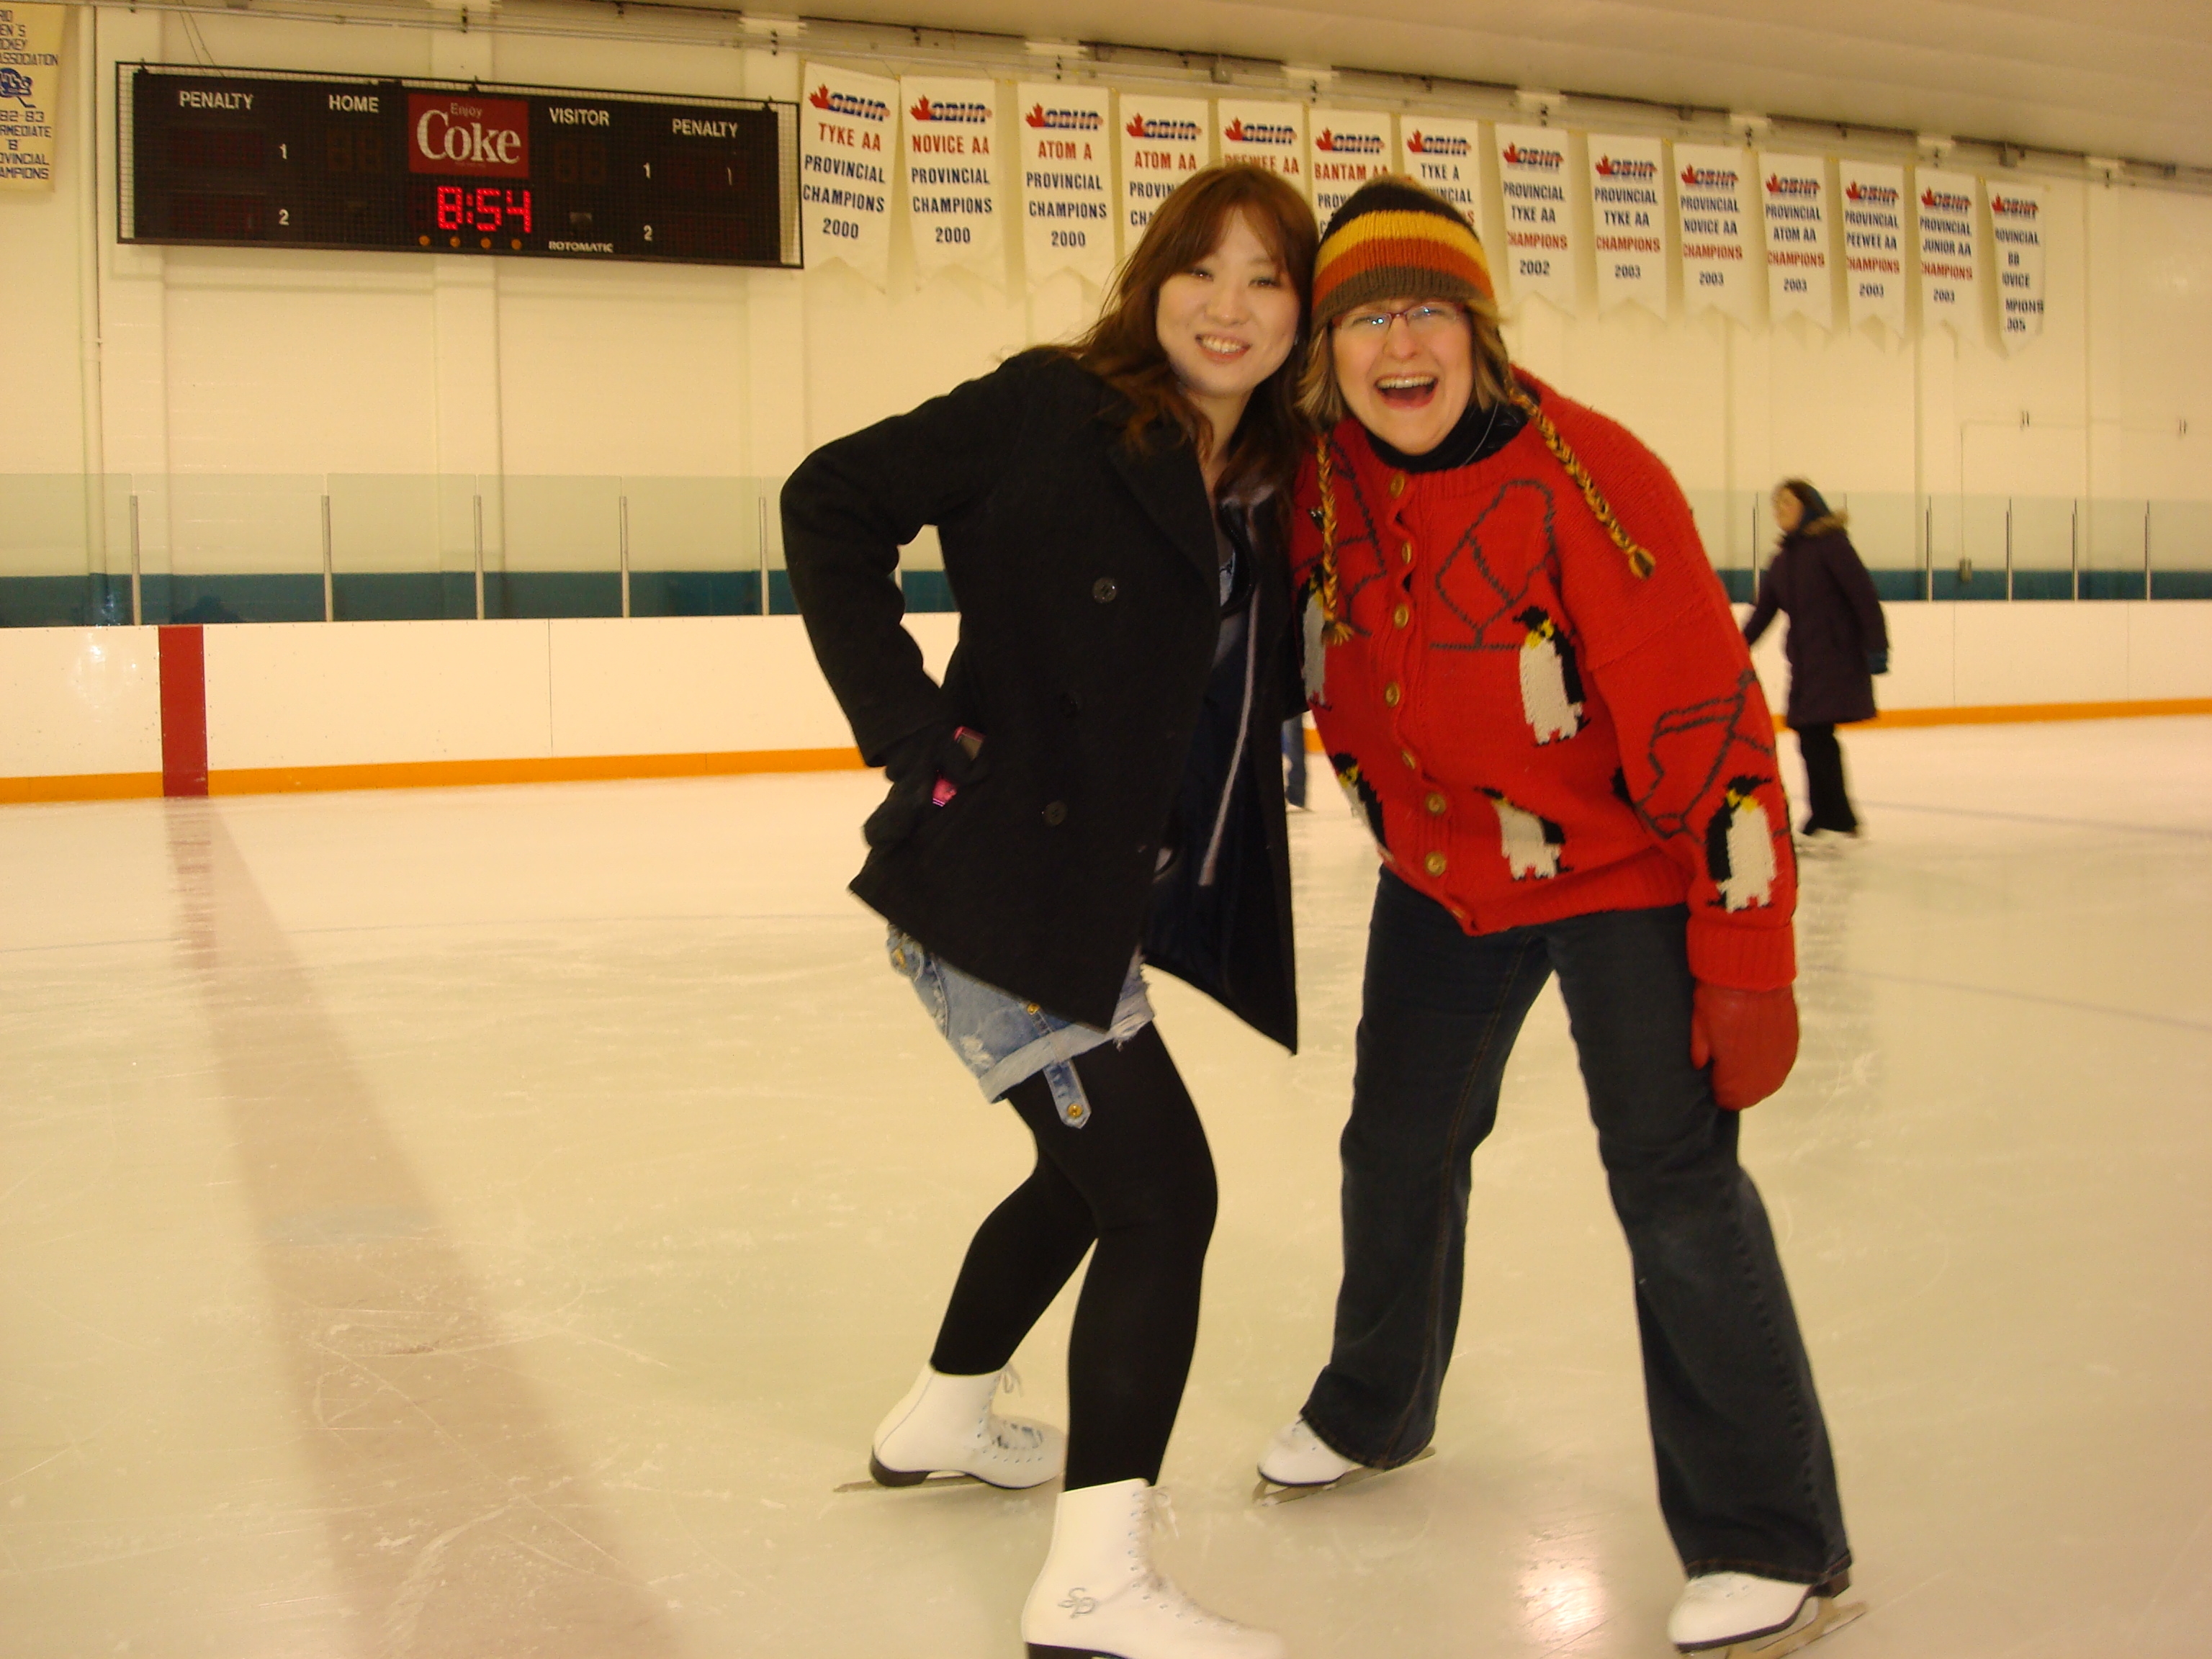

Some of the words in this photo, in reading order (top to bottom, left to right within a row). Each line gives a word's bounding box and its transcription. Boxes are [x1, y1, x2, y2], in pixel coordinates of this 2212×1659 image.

[179, 90, 253, 111] PENALTY
[328, 94, 379, 113] HOME
[450, 102, 483, 119] Enjoy
[549, 107, 610, 127] VISITOR
[417, 109, 521, 164] Coke
[672, 118, 738, 138] PENALTY
[819, 122, 855, 147] TYKE
[861, 130, 881, 152] AA
[279, 143, 287, 159] 1
[912, 134, 964, 154] NOVICE
[972, 135, 990, 155] AA
[1038, 140, 1076, 161] ATOM
[1084, 142, 1093, 161] A
[805, 154, 886, 184] PROVINCIAL
[1135, 150, 1171, 169] ATOM
[1179, 152, 1197, 170] AA
[1283, 155, 1299, 174] AA
[643, 163, 651, 179] 1
[911, 166, 991, 185] PROVINCIAL
[1314, 162, 1366, 181] BANTAM
[1421, 162, 1447, 179] TYKE
[1453, 164, 1460, 181] A
[1026, 171, 1103, 191] PROVINCIAL
[1130, 181, 1178, 198] PROVIN
[802, 184, 884, 213] CHAMPIONS
[1503, 180, 1565, 202] PROVINCIAL
[1595, 186, 1658, 206] PROVINCIAL
[437, 185, 531, 233] 8:54
[912, 196, 993, 214] CHAMPIONS
[1028, 200, 1107, 219] CHAMPIONS
[1681, 194, 1740, 213] PROVINCIAL
[1766, 203, 1822, 221] PROVINCIAL
[279, 209, 289, 225] 2
[1511, 204, 1537, 222] TYKE
[1541, 206, 1556, 223] AA
[1604, 210, 1631, 227] TYKE
[1635, 211, 1650, 228] AA
[1845, 210, 1899, 230] PROVINCIAL
[644, 225, 652, 241] 2
[822, 217, 859, 239] 2000
[935, 226, 971, 244] 2000
[1684, 217, 1719, 234] NOVICE
[1723, 219, 1738, 235] AA
[1773, 225, 1800, 243] ATOM
[1920, 217, 1972, 237] PROVINCIAL
[549, 240, 613, 253] ROTOMATIC
[1051, 230, 1086, 248] 2000
[1596, 235, 1660, 253] CHAMPIONS
[1683, 243, 1743, 261] CHAMPIONS
[1768, 250, 1825, 268] CHAMPIONS
[1519, 259, 1550, 276] 2002
[1614, 264, 1640, 279] 2003
